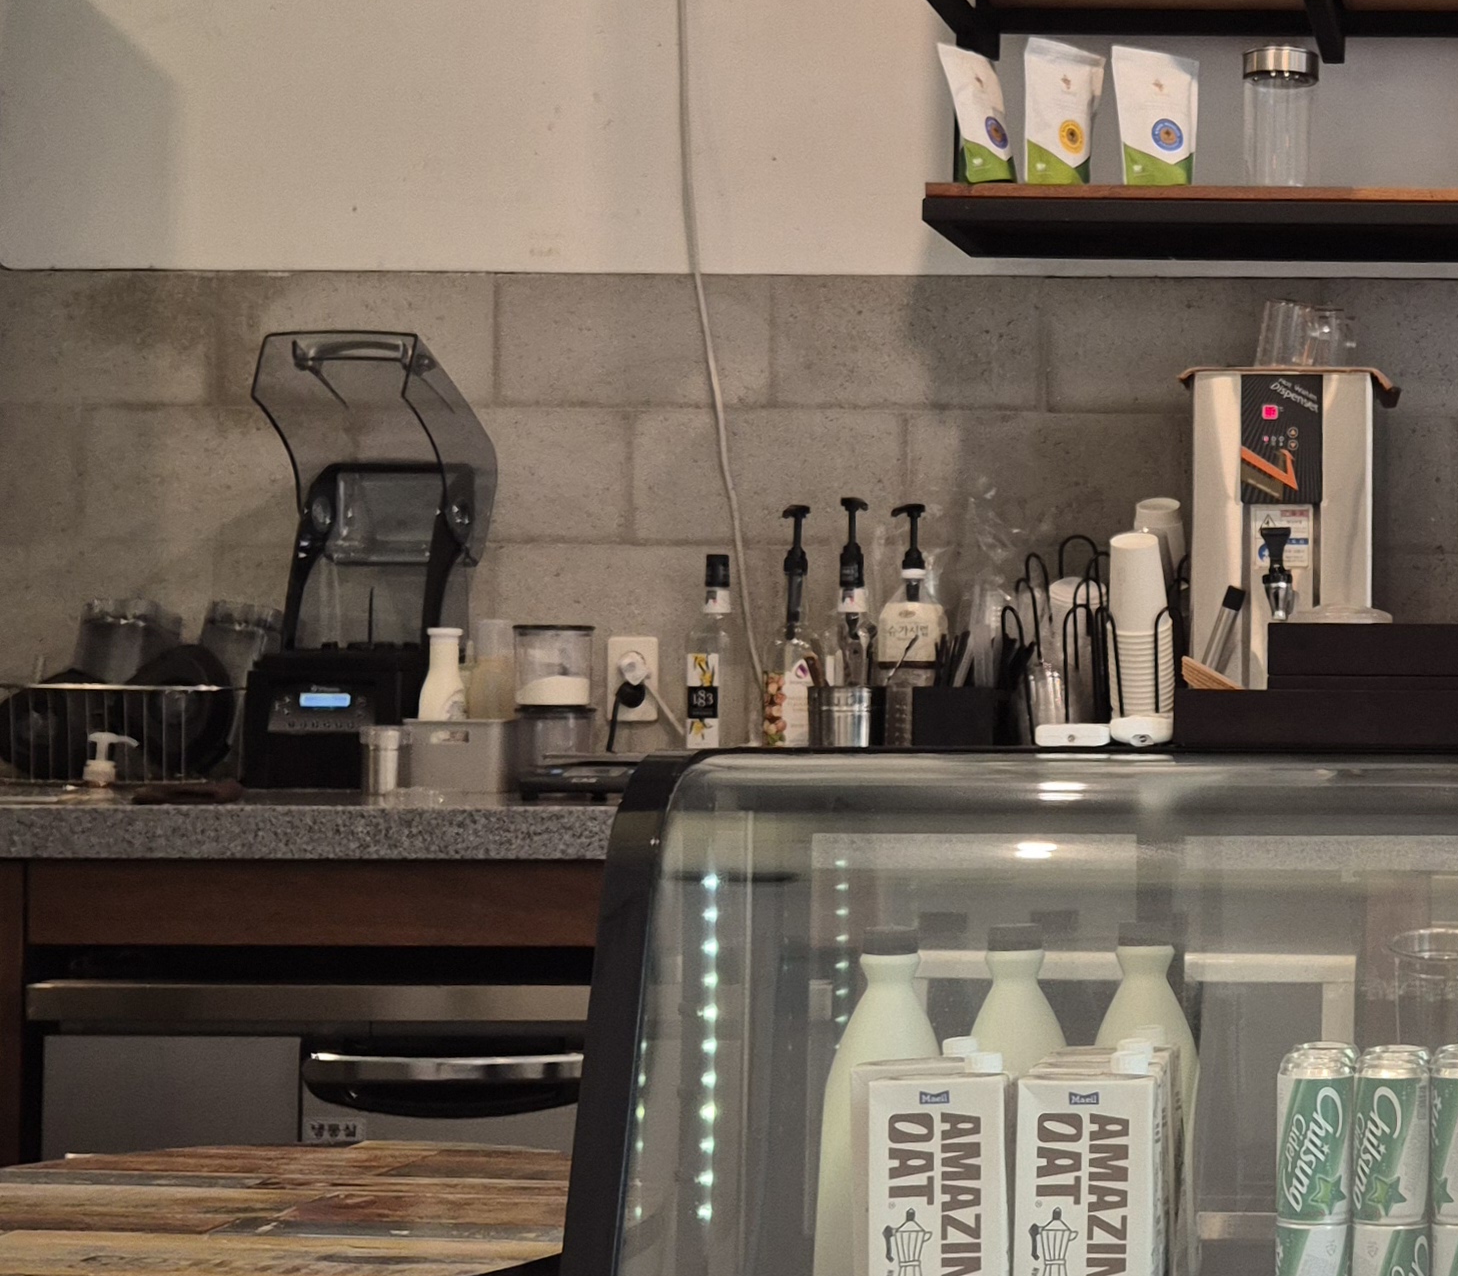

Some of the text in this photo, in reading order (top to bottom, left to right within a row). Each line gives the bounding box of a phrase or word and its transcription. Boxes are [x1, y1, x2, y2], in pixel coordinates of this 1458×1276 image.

[888, 1112, 935, 1206] OAT
[1035, 1112, 1083, 1206] OAT
[1282, 1086, 1343, 1213] Chilsung
[1285, 1113, 1306, 1173] Cider
